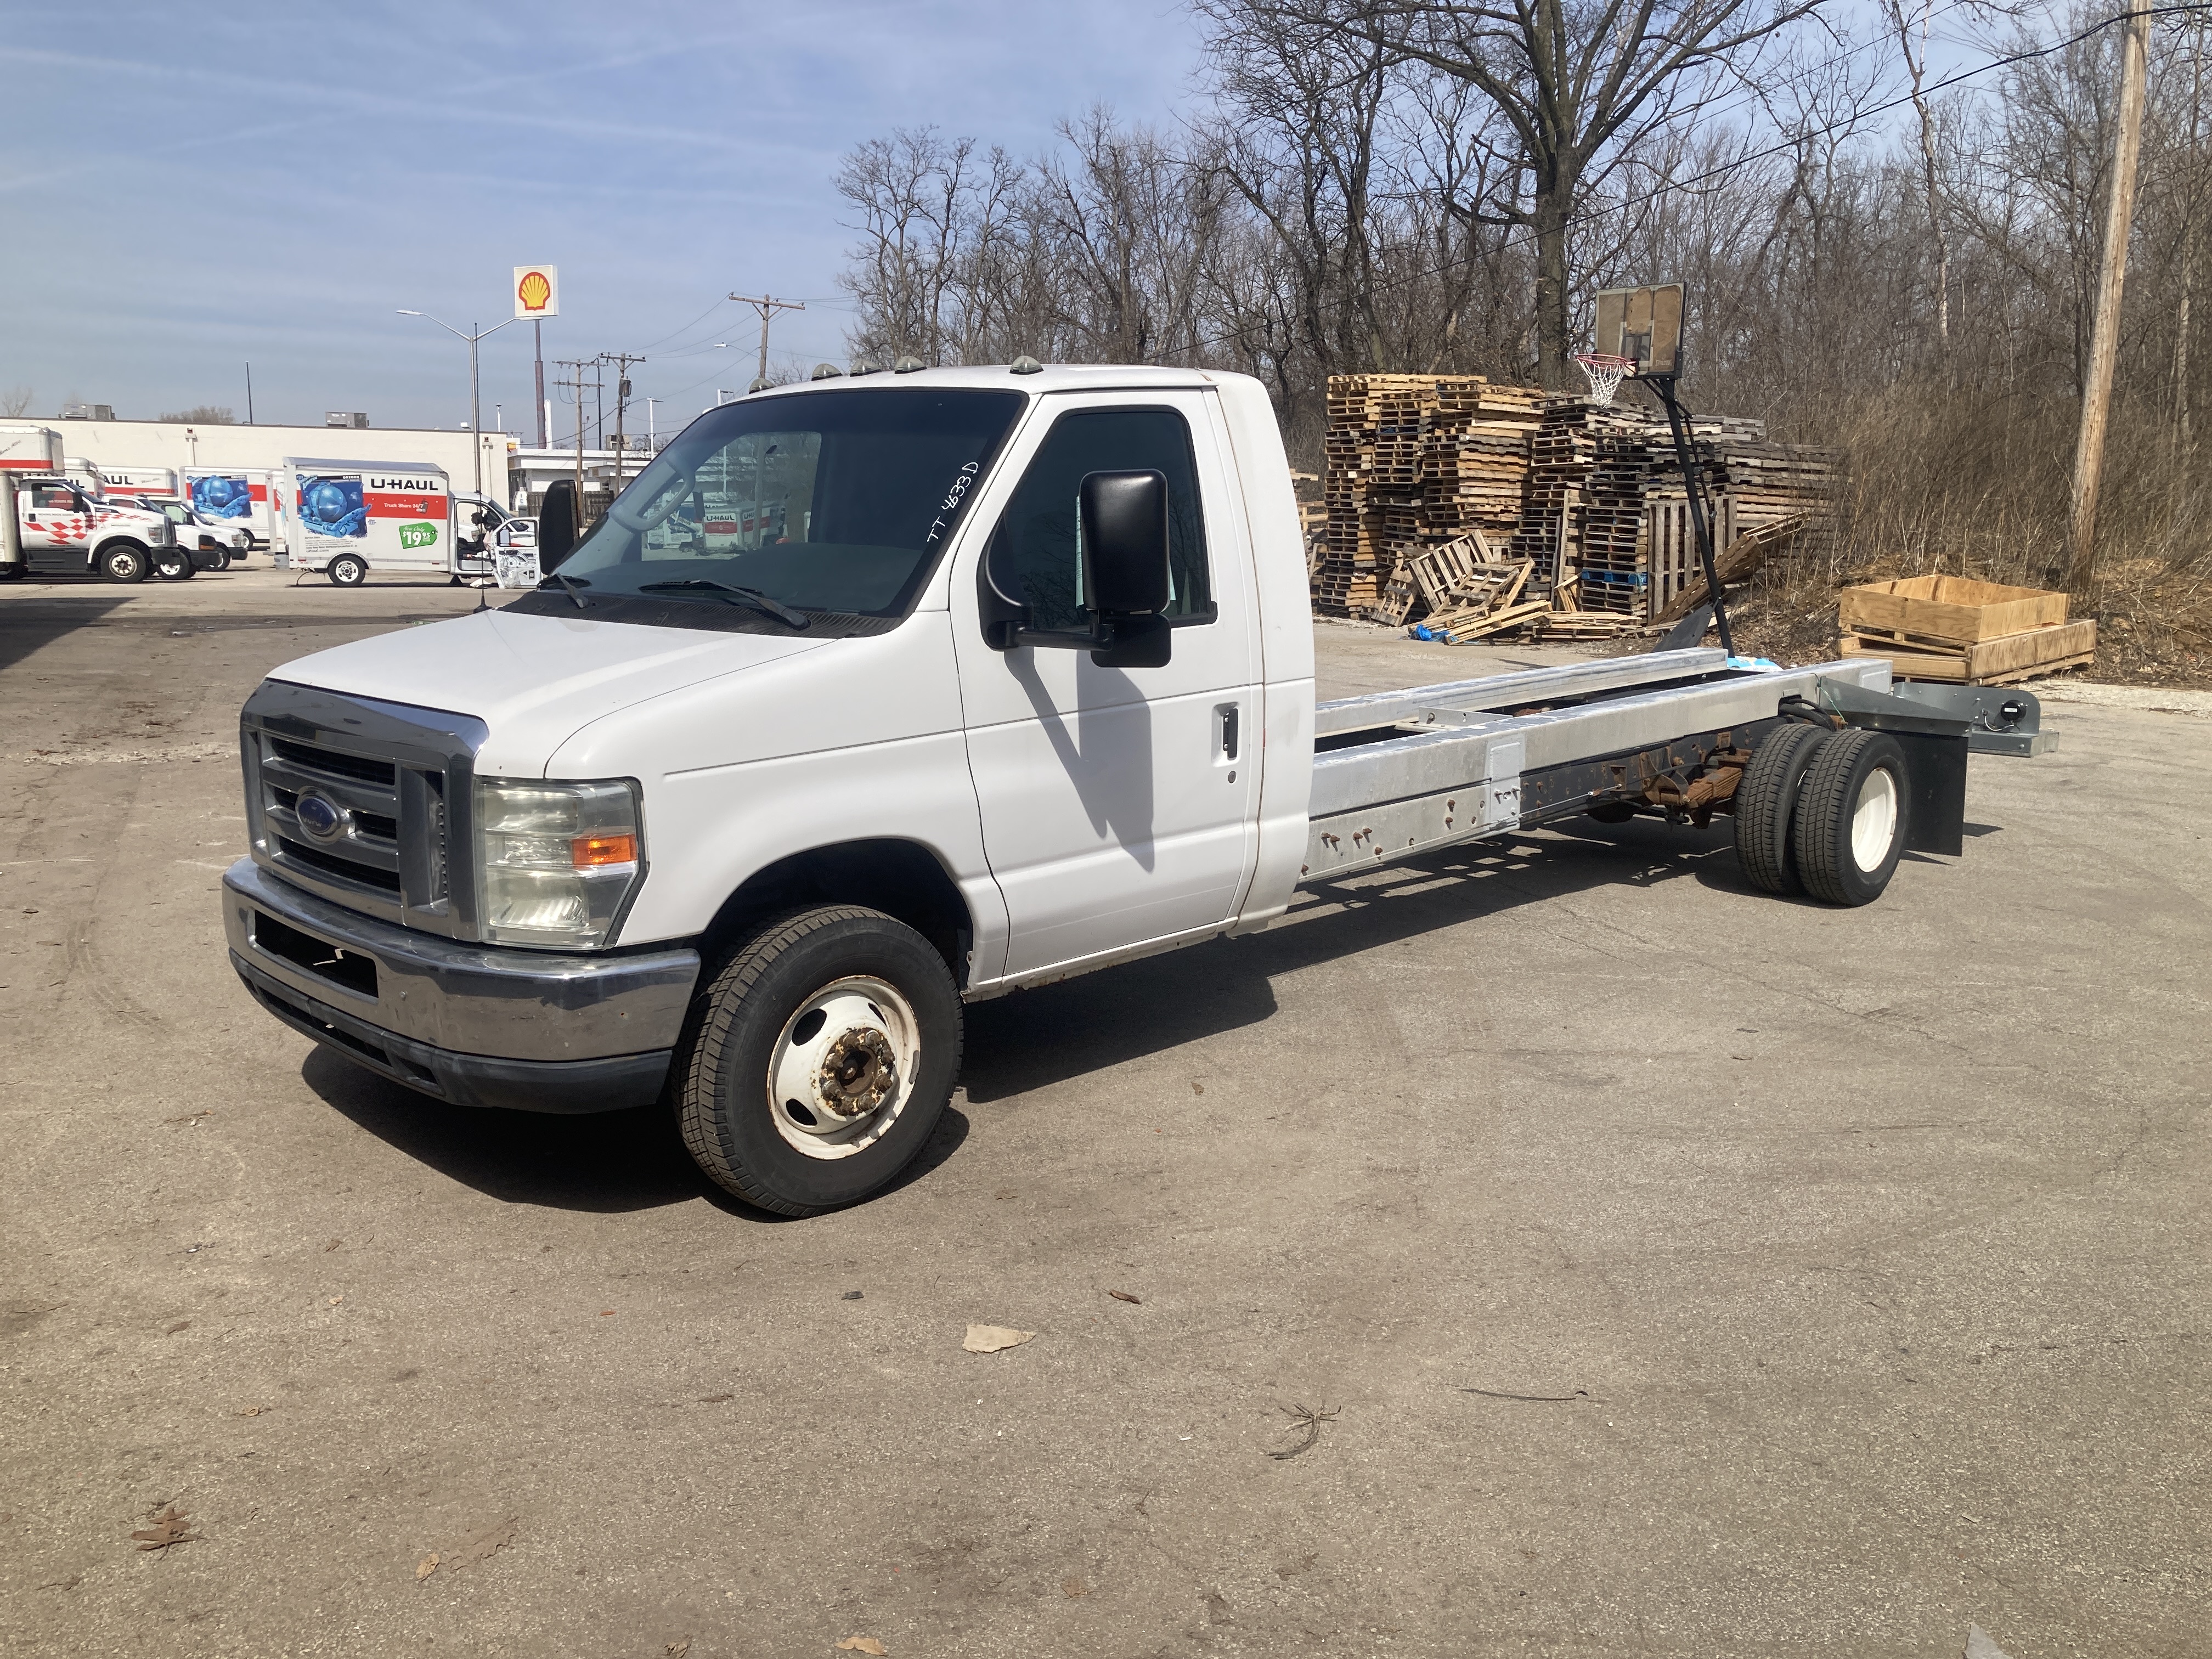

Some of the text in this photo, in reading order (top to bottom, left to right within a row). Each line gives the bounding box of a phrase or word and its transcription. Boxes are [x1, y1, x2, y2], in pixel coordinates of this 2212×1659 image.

[104, 475, 134, 485] AUL
[371, 478, 438, 491] U-HAUL
[941, 476, 972, 510] 4633
